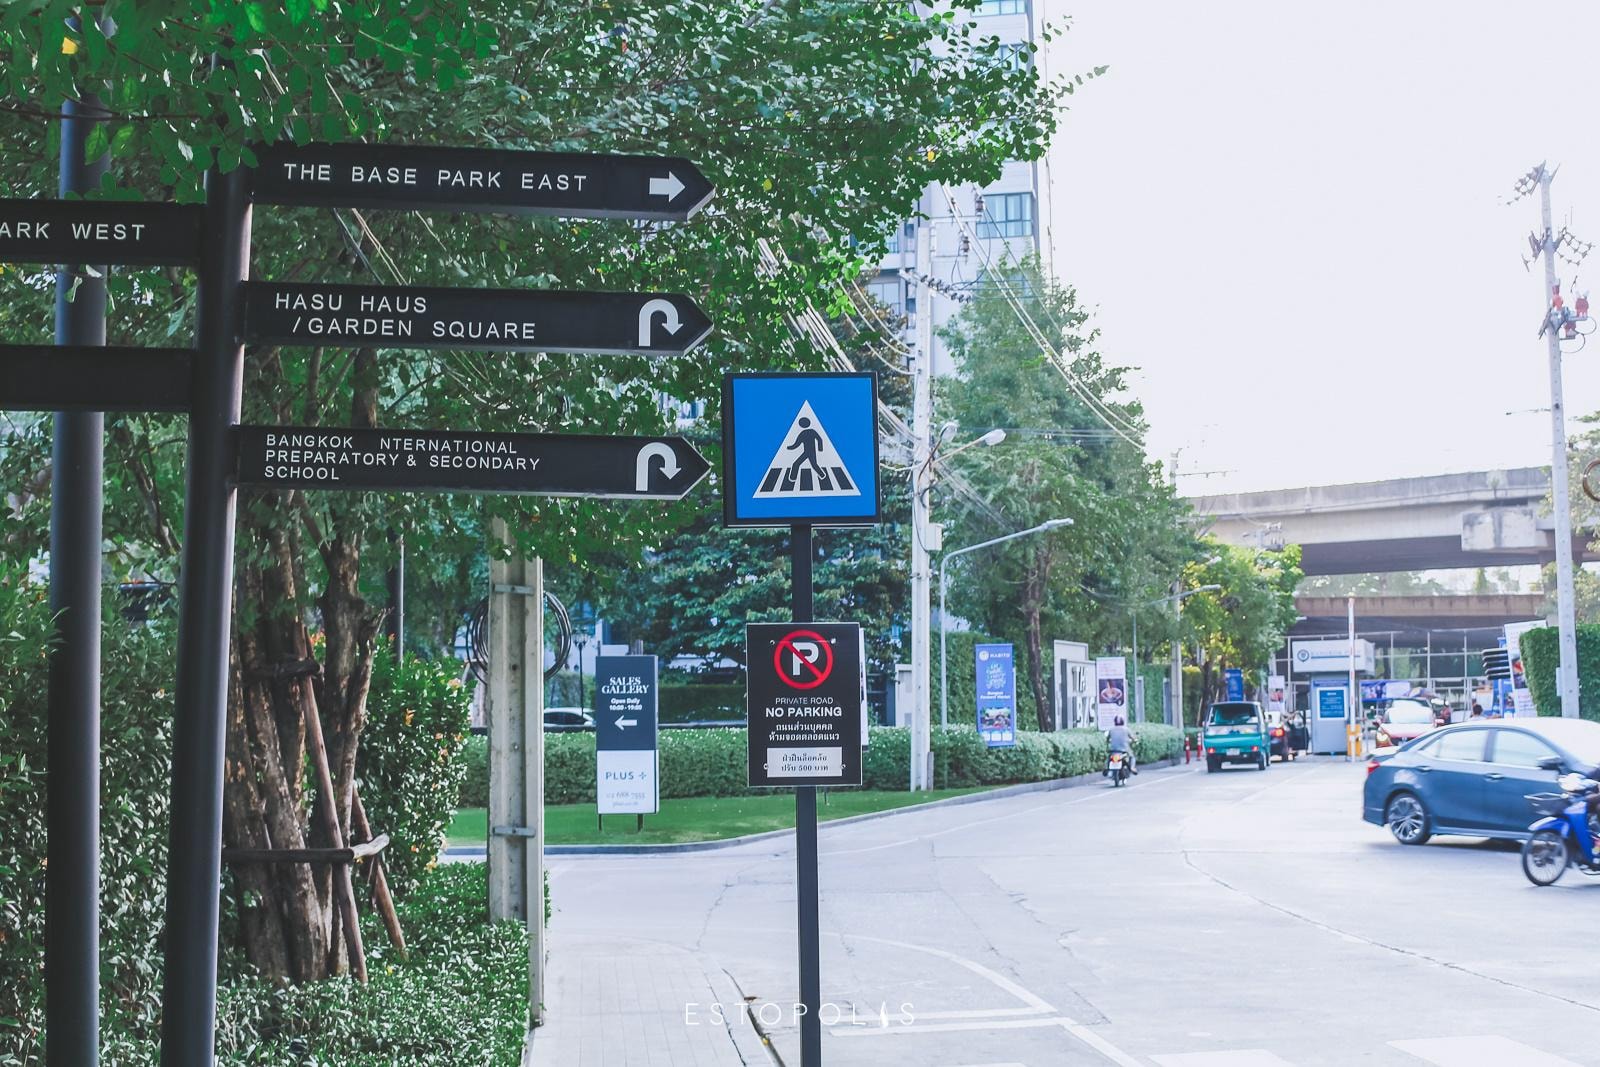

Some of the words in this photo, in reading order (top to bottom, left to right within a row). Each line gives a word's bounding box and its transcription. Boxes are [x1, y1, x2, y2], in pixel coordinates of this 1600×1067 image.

[283, 163, 331, 181] THE
[351, 166, 417, 185] BASE
[437, 169, 502, 188] PARK
[521, 172, 588, 192] EAST
[71, 223, 146, 241] WEST
[275, 292, 342, 311] HASU
[360, 295, 427, 314] HAUS
[292, 316, 412, 337] /GARDEN
[432, 320, 536, 340] SQUARE
[265, 434, 354, 450] BANGKOK
[265, 449, 400, 467] PREPARATORY
[405, 455, 417, 467] &
[429, 456, 541, 471] SECONDARY
[264, 465, 340, 480] SCHOOL
[609, 676, 641, 686] SALES
[601, 684, 649, 695] GALLERY
[610, 697, 626, 705] Open
[775, 697, 808, 705] PRIVATE
[810, 696, 834, 705] ROAD
[765, 707, 785, 718] NO
[787, 706, 843, 718] PARKING
[775, 721, 834, 733] ถนนส่วนบุคคล
[798, 764, 812, 772] 500
[605, 771, 635, 780] PLUS
